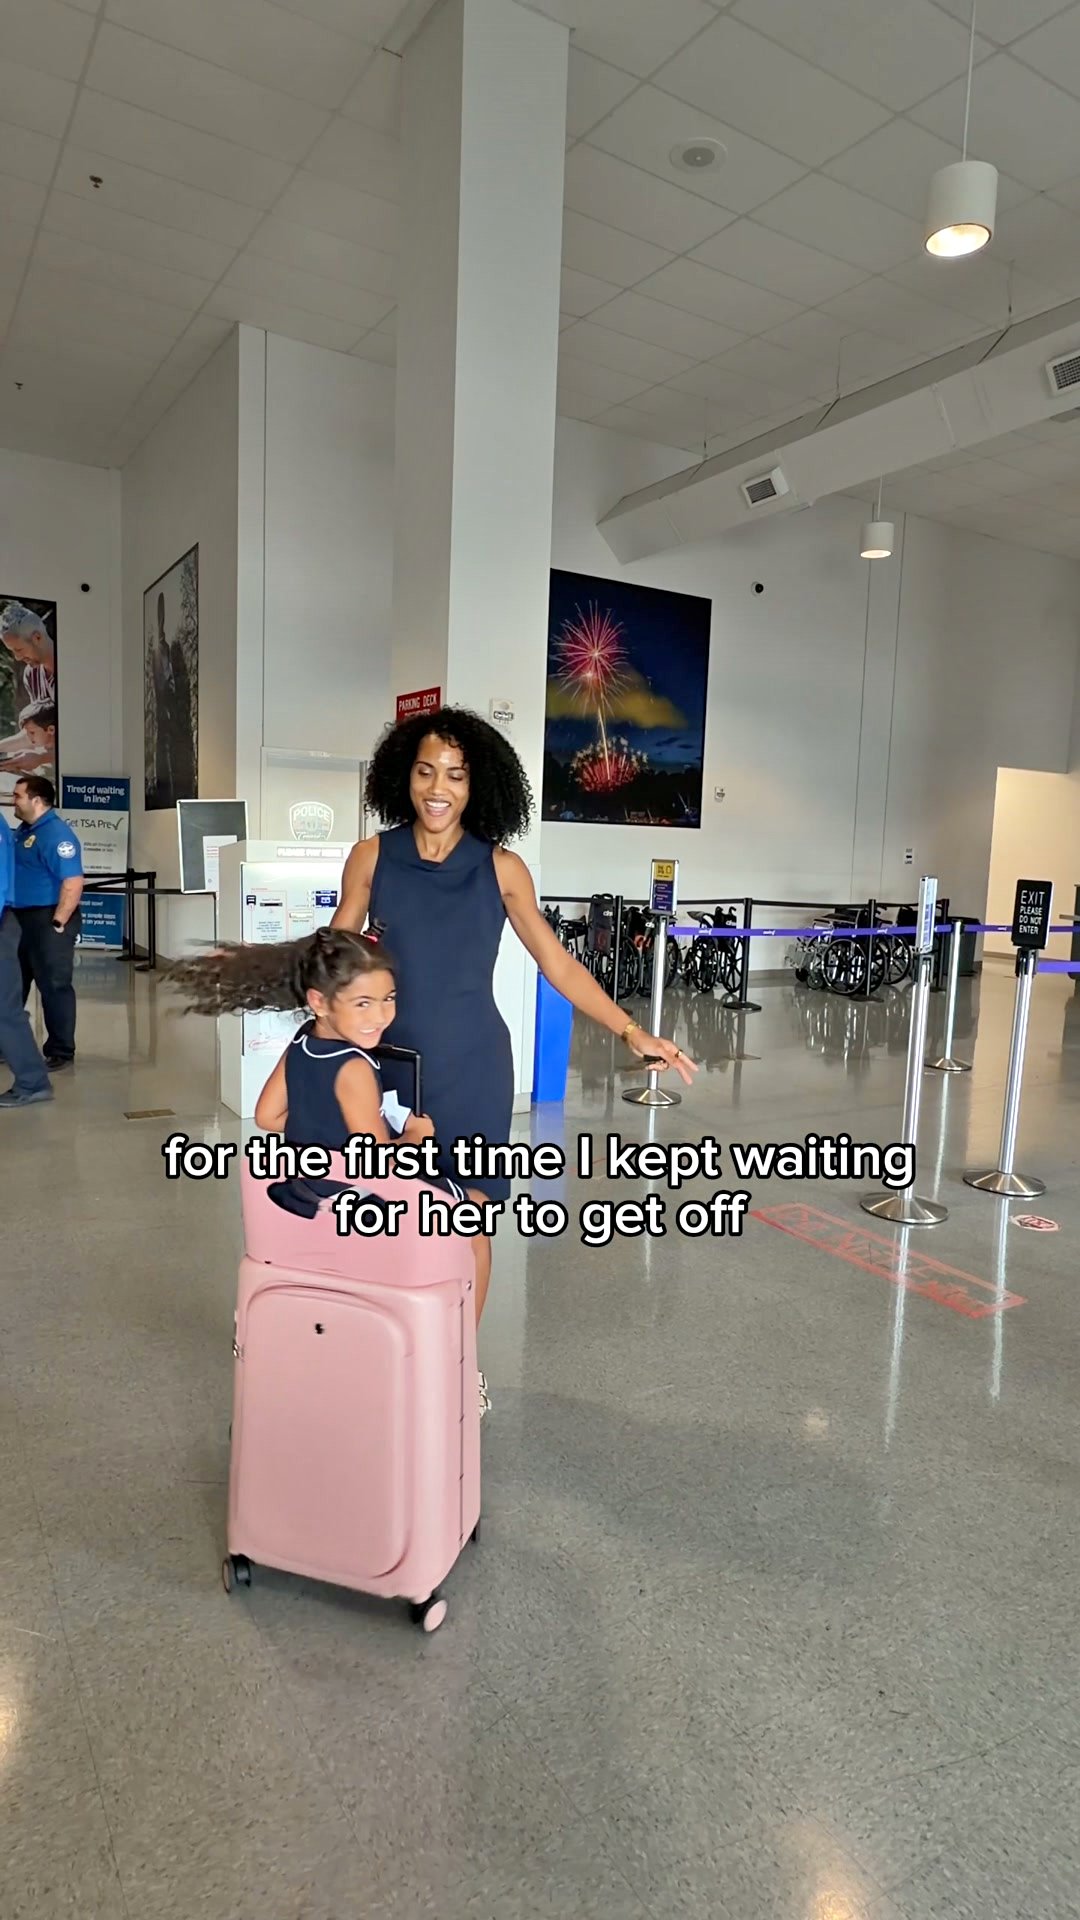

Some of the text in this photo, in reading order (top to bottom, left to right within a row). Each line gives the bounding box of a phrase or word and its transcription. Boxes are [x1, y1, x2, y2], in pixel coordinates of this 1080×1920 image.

[399, 693, 437, 712] PARKING DECK
[66, 785, 125, 796] Tired of waiting
[83, 795, 111, 804] in line?
[293, 805, 330, 822] POLICE
[81, 818, 96, 828] TSA
[306, 848, 321, 857] PAY
[1020, 890, 1045, 905] EXIT
[1020, 906, 1043, 916] PLEASE
[1019, 915, 1043, 925] DO NOT
[1019, 924, 1039, 935] ENTER
